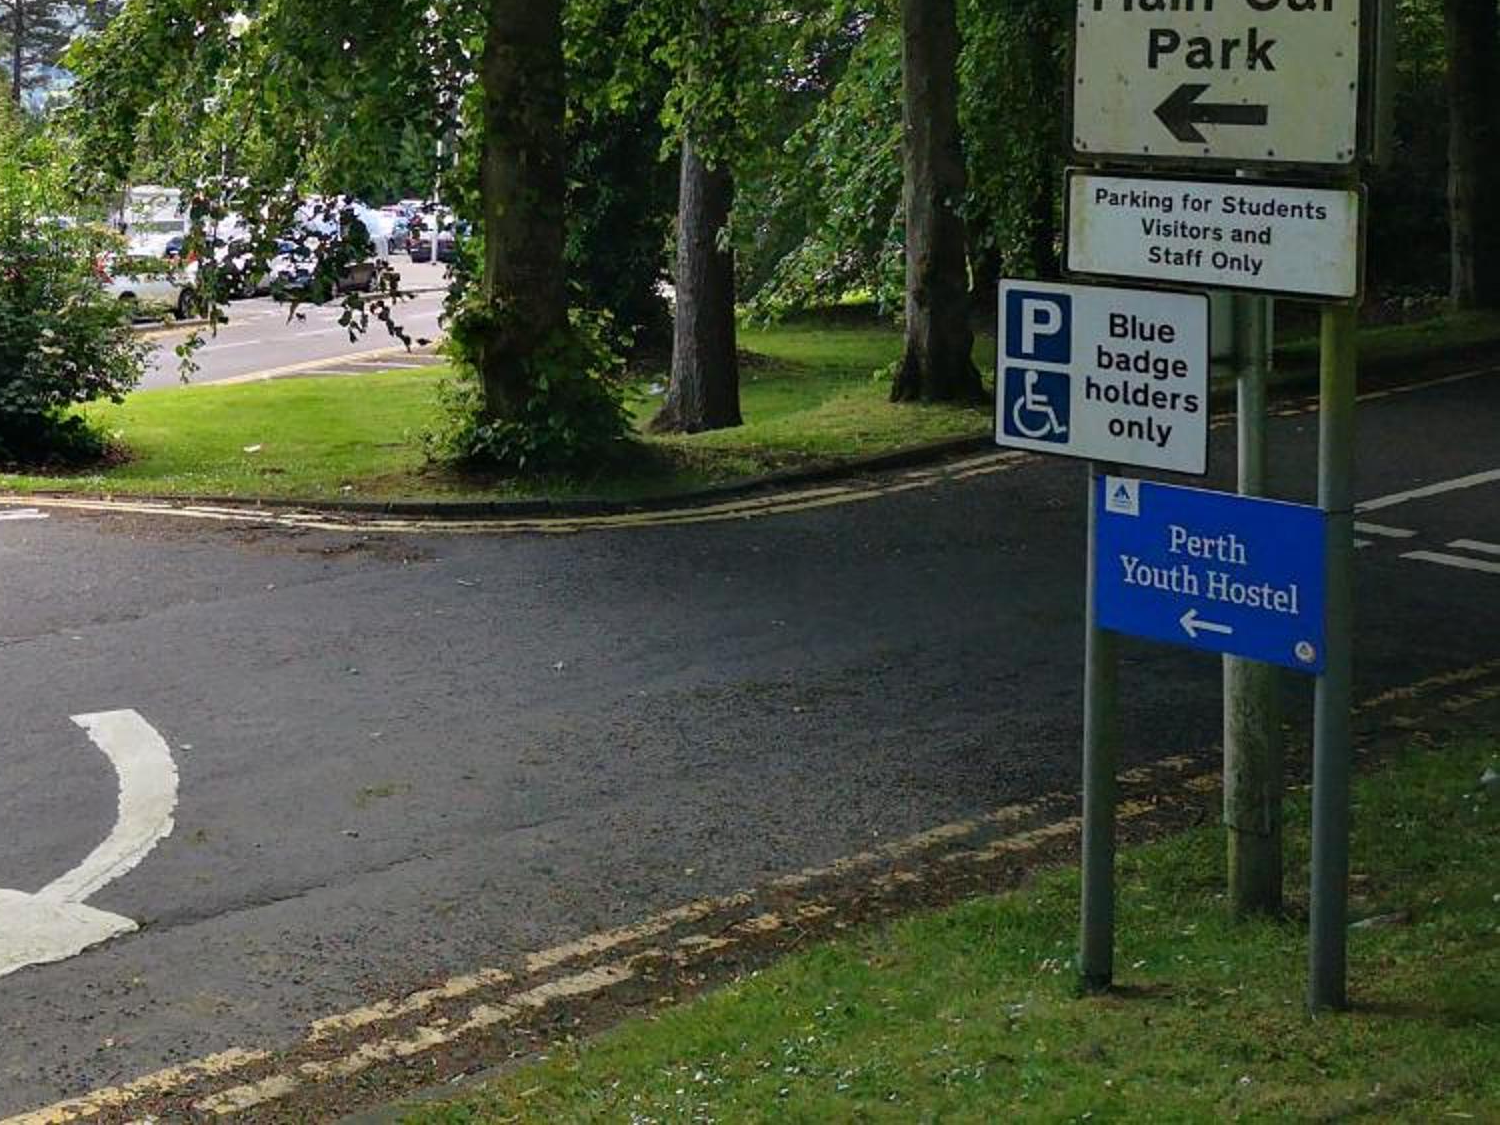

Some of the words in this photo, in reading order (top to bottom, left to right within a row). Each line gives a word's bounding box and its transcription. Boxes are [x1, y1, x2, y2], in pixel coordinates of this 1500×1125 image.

[1147, 26, 1278, 72] Park
[1094, 187, 1174, 213] Parking
[1182, 193, 1213, 212] for
[1221, 196, 1328, 221] Students
[1141, 218, 1223, 242] Visitors
[1231, 226, 1272, 245] and
[1148, 246, 1203, 267] Staff
[1211, 251, 1263, 276] Only
[1021, 298, 1063, 355] P
[1109, 312, 1176, 344] Blue
[1096, 345, 1188, 381] badge
[1085, 376, 1199, 413] holders
[1108, 417, 1173, 448] only
[1168, 524, 1247, 565] Perth
[1119, 554, 1199, 596] Youth
[1206, 570, 1299, 615] Hostel
